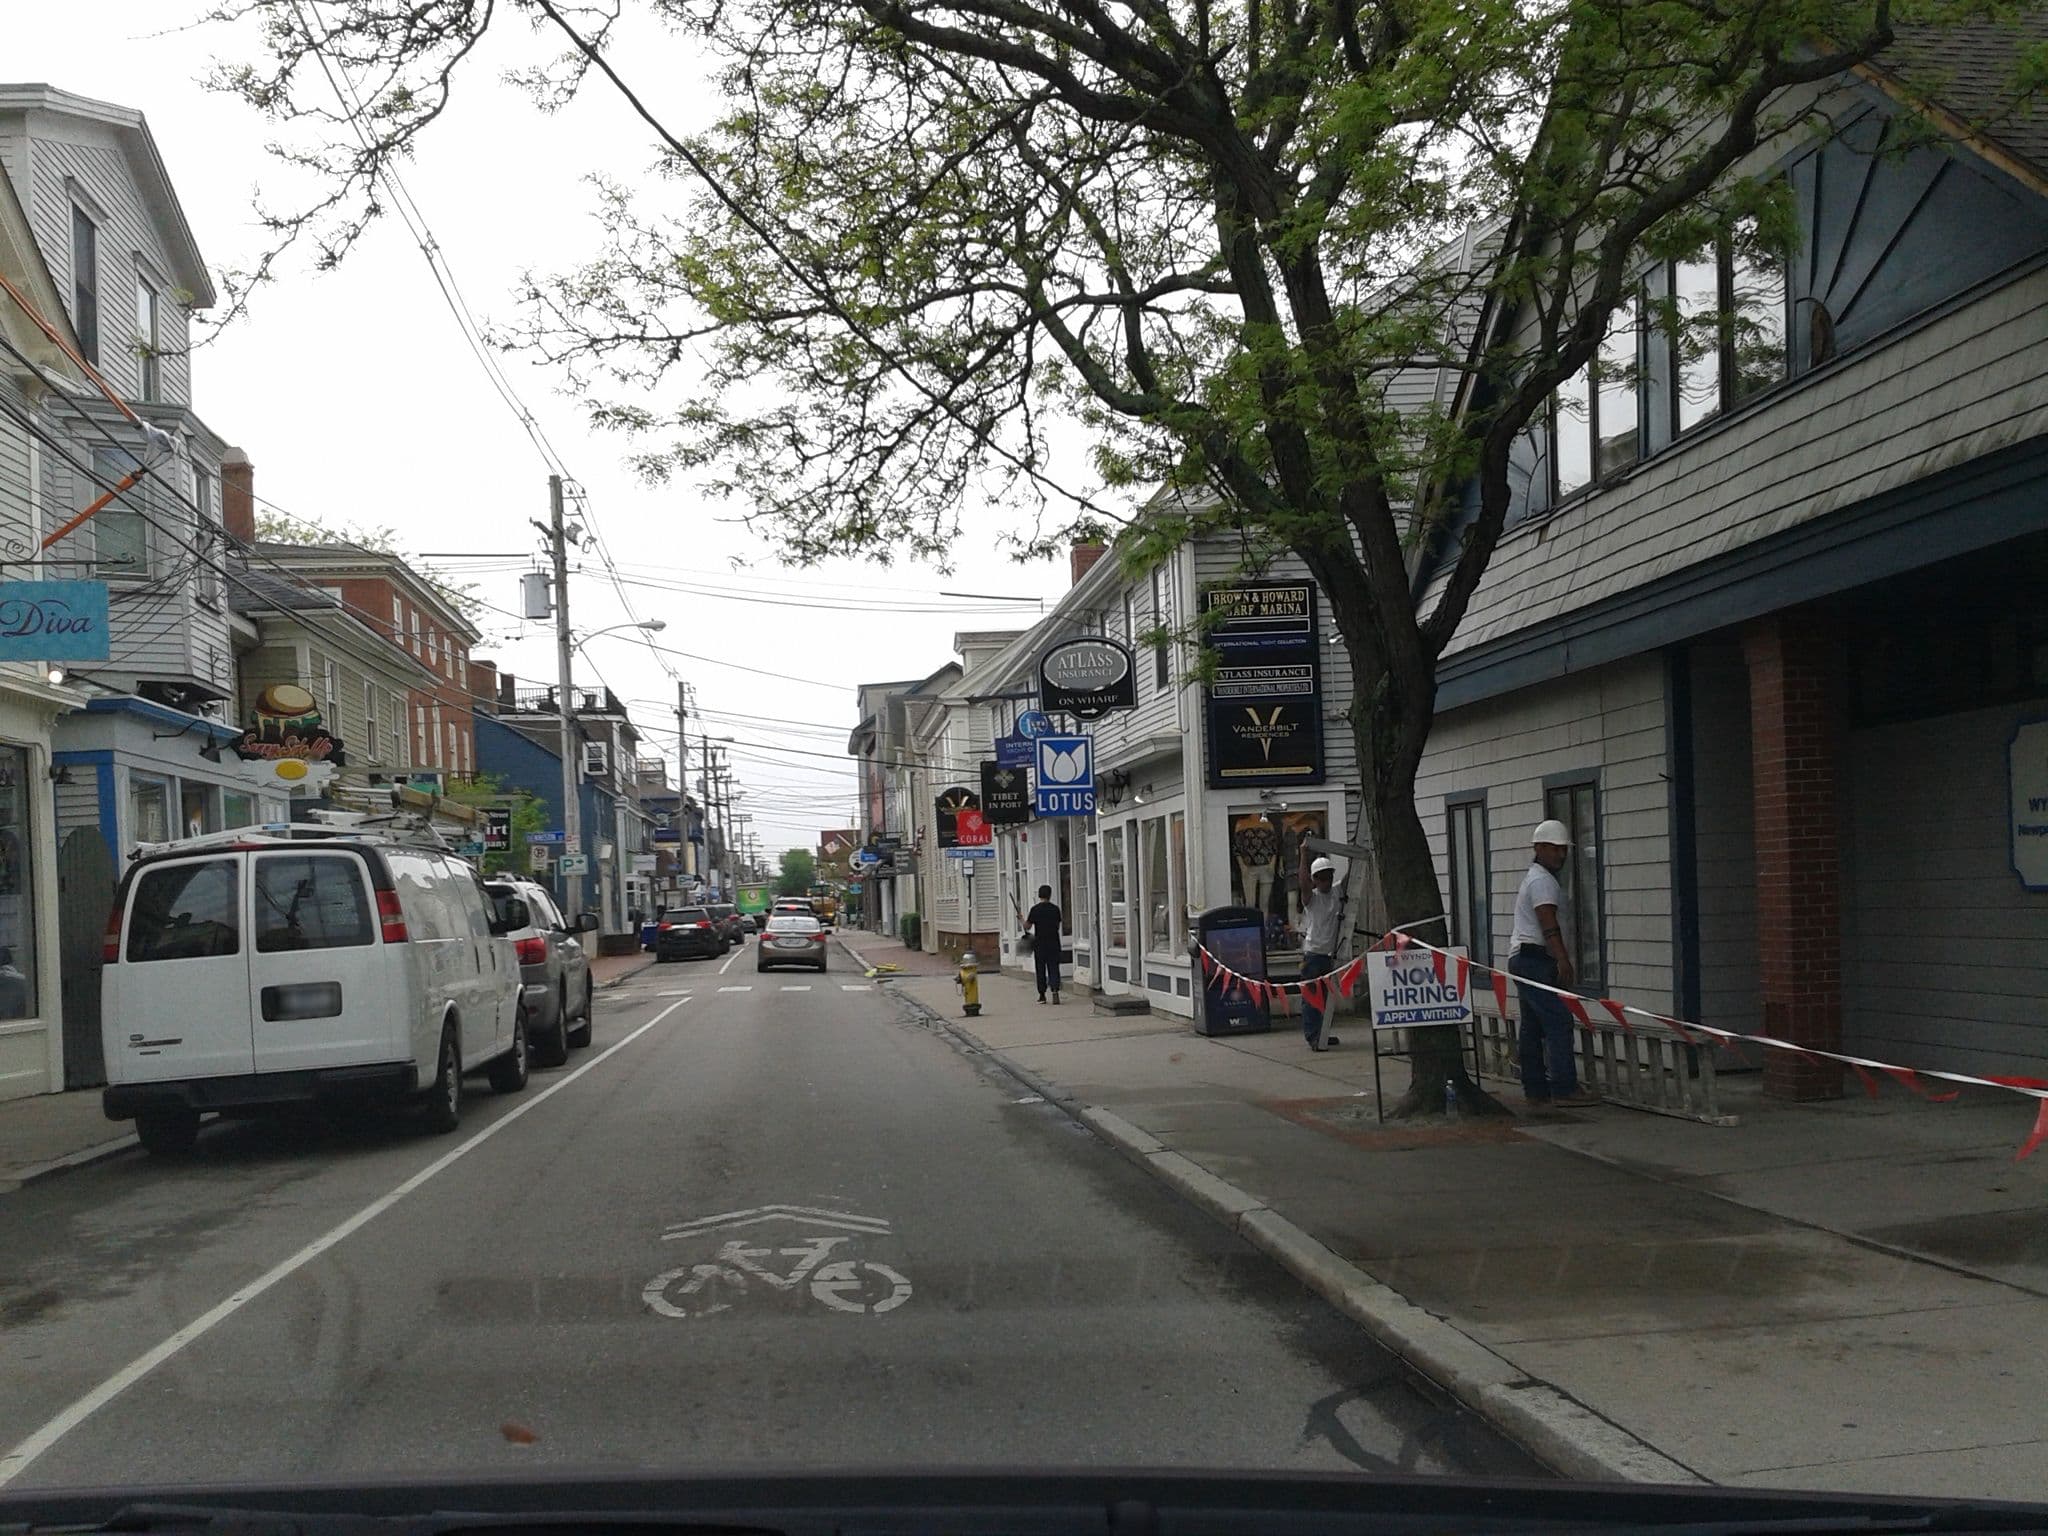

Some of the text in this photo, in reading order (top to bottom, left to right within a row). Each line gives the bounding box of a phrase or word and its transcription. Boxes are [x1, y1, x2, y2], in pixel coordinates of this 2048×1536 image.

[1213, 591, 1305, 605] BROWN & HOWARD
[1260, 603, 1302, 615] MARINA
[0, 600, 96, 637] Diva
[1058, 651, 1113, 669] ATLASS
[1058, 668, 1113, 679] INSURANCE
[1217, 667, 1307, 680] ATLASS INSURANCE
[1058, 694, 1118, 705] ON WHARF
[1232, 723, 1299, 733] VANDERBILT
[992, 792, 1020, 801] TIBET
[1038, 792, 1094, 811] LOTUS
[1000, 800, 1022, 809] PORT
[960, 834, 990, 844] CORAL
[1384, 985, 1458, 1007] HIRING
[1384, 1007, 1461, 1023] APPLY WITHIN
